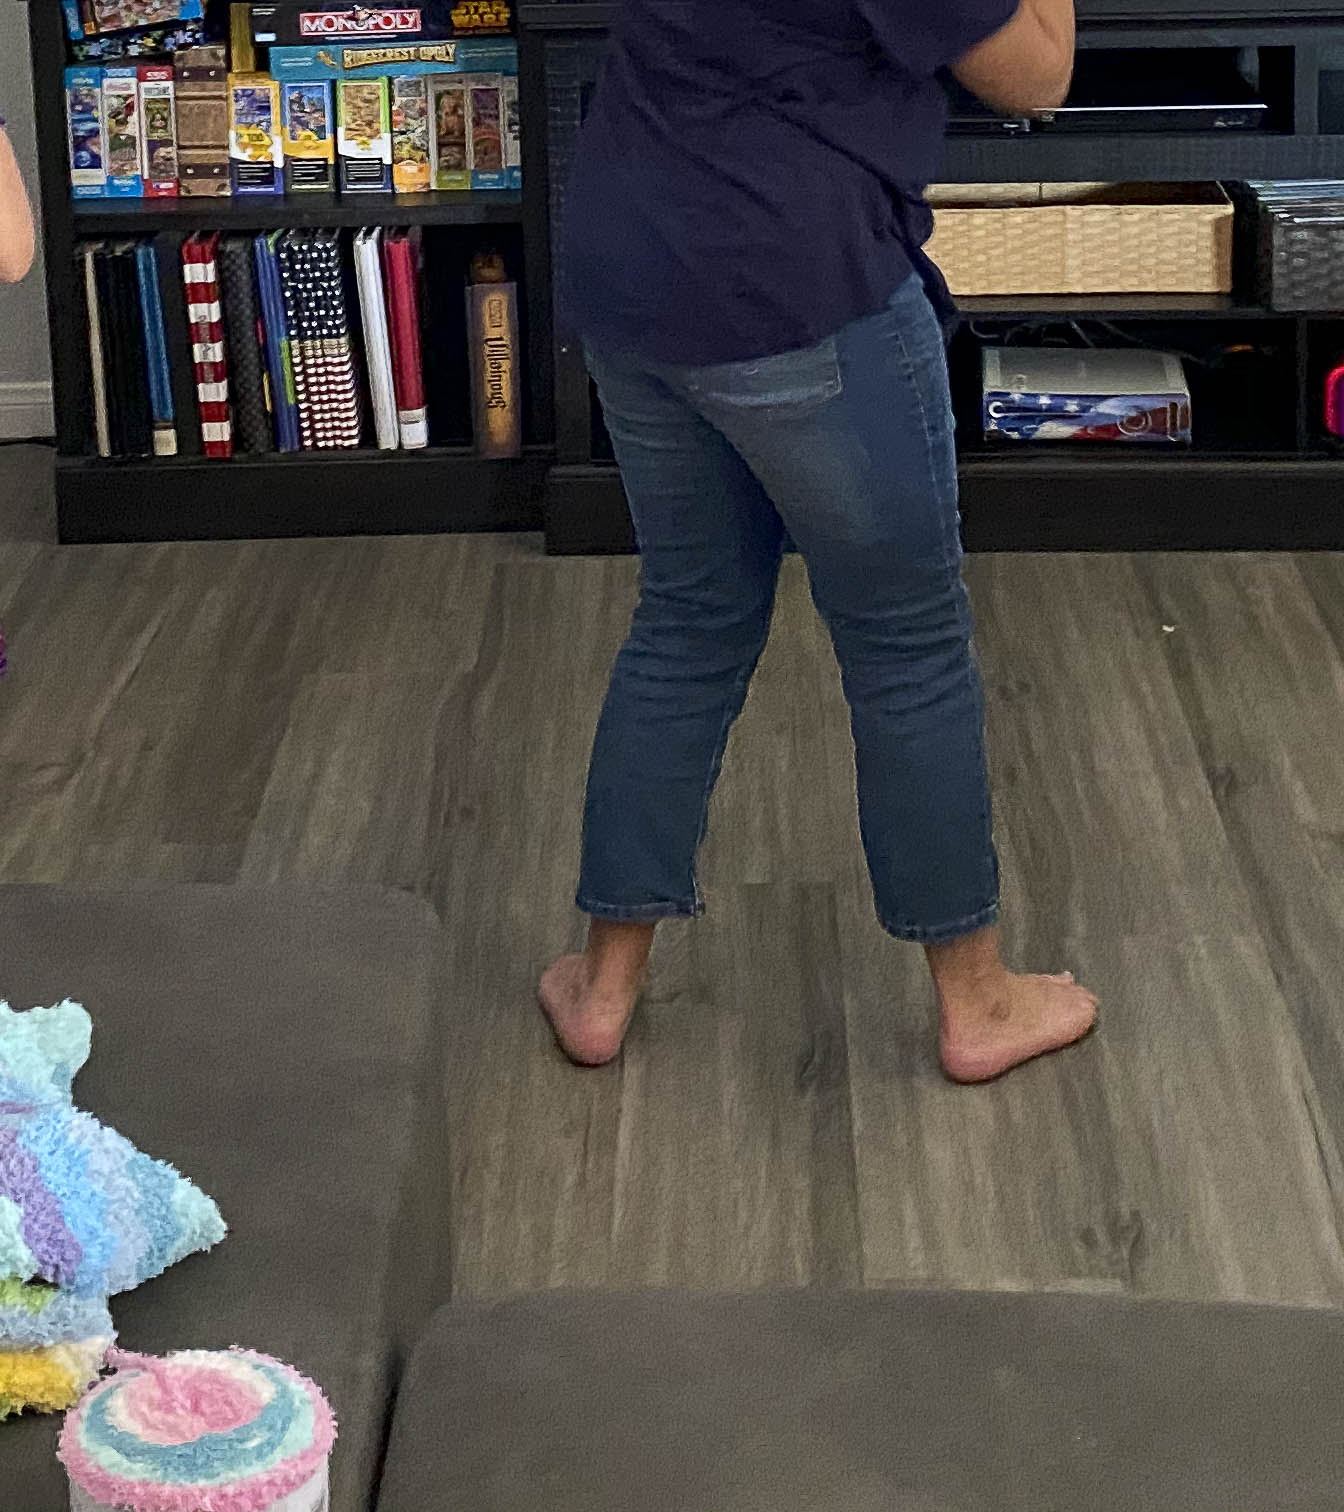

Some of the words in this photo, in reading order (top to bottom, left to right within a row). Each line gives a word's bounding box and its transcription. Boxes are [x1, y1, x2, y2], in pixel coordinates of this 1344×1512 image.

[450, 0, 510, 14] STAR
[303, 12, 415, 32] MONOPOLY
[451, 14, 510, 28] WARS
